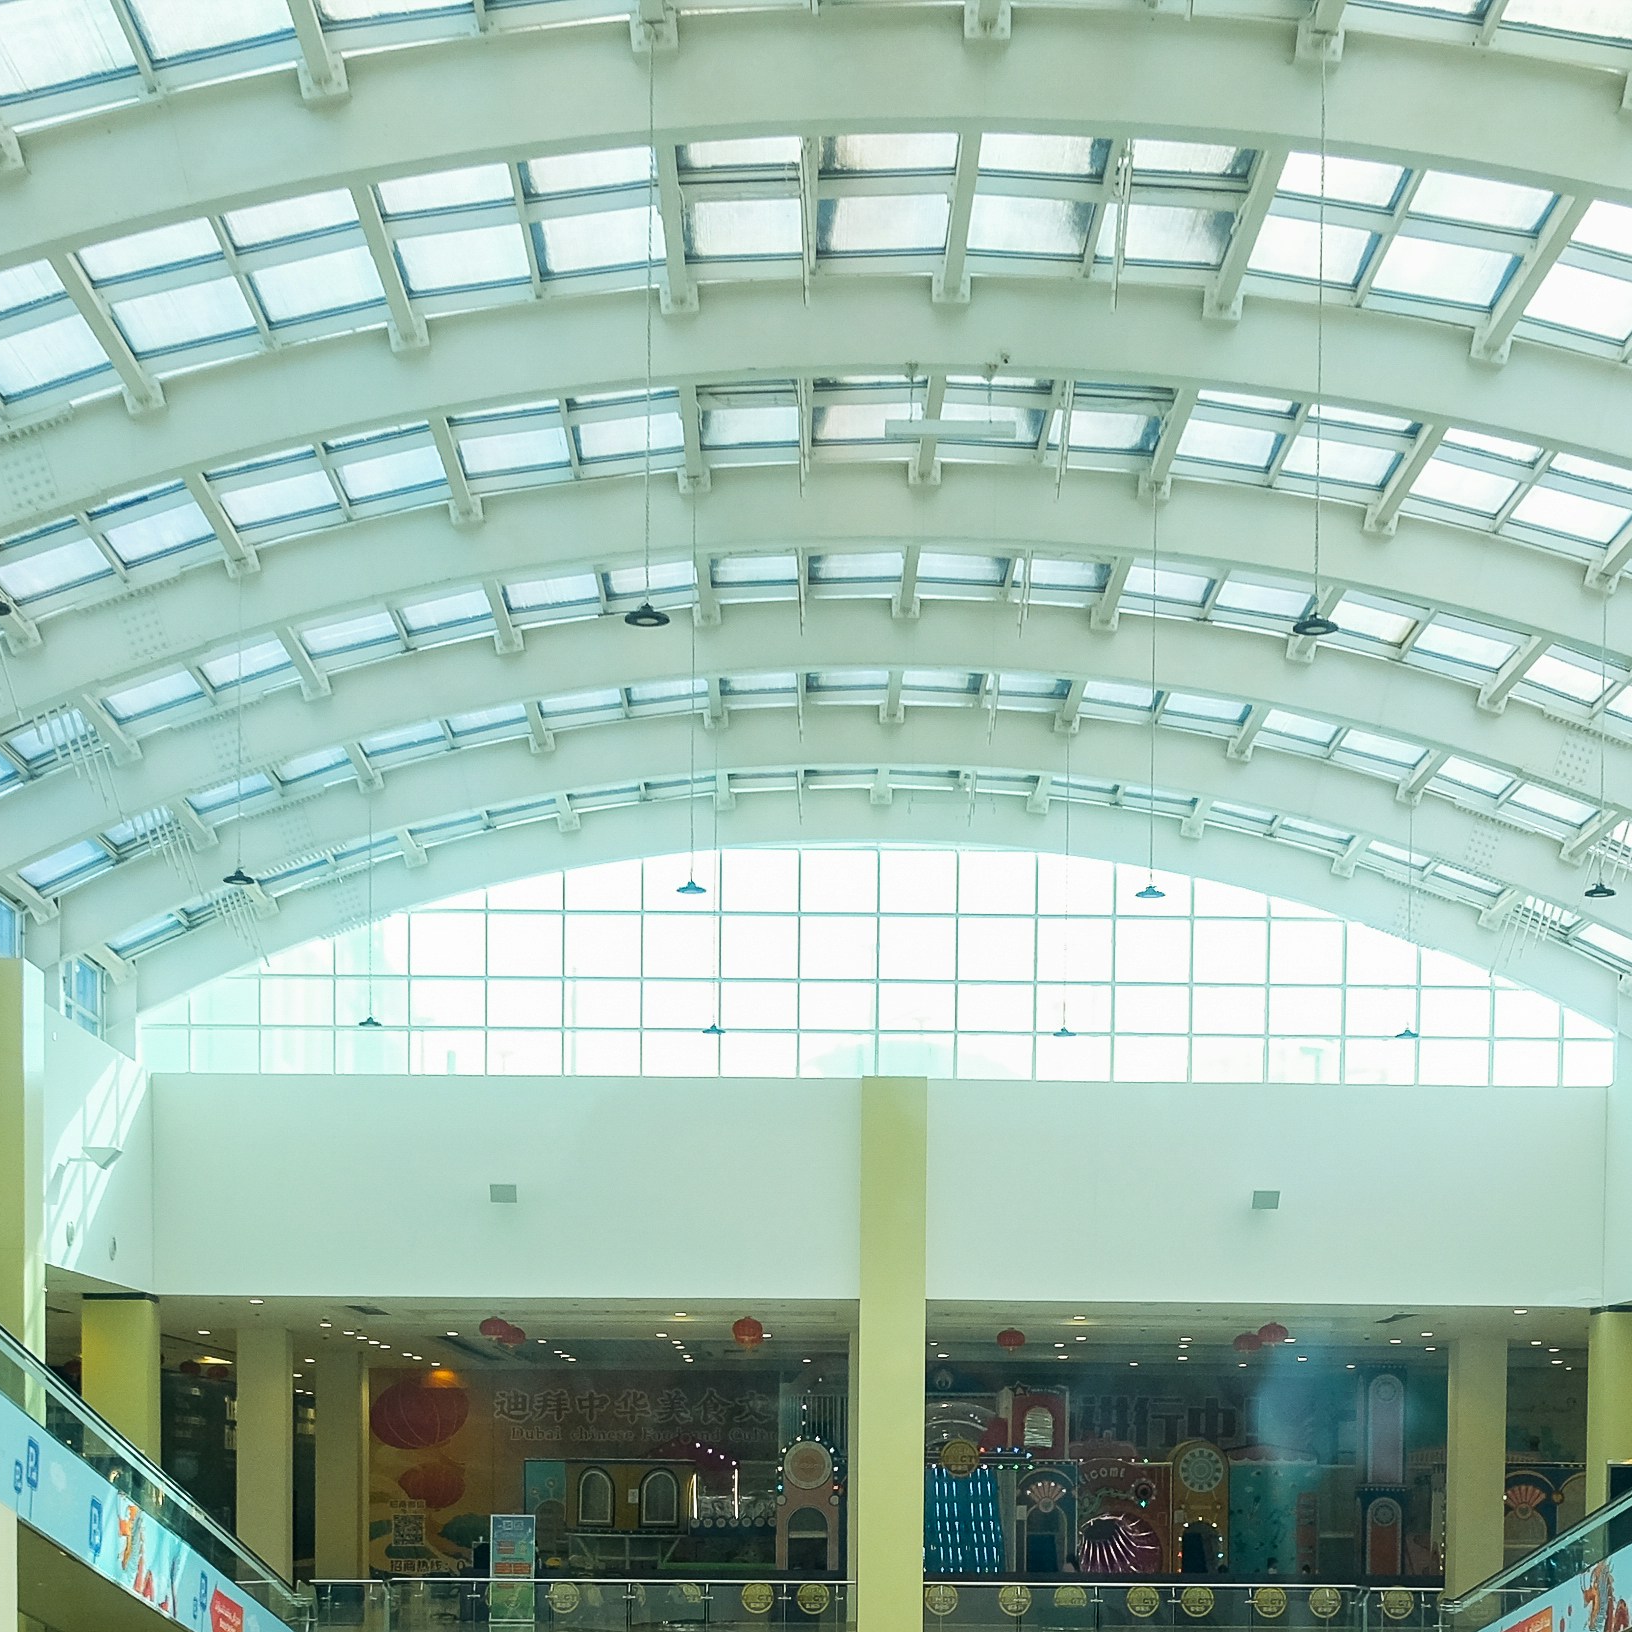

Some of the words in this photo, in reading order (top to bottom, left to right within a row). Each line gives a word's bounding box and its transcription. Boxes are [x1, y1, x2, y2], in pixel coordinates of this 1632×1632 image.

[493, 1388, 777, 1424] 迪拜中华美食文
